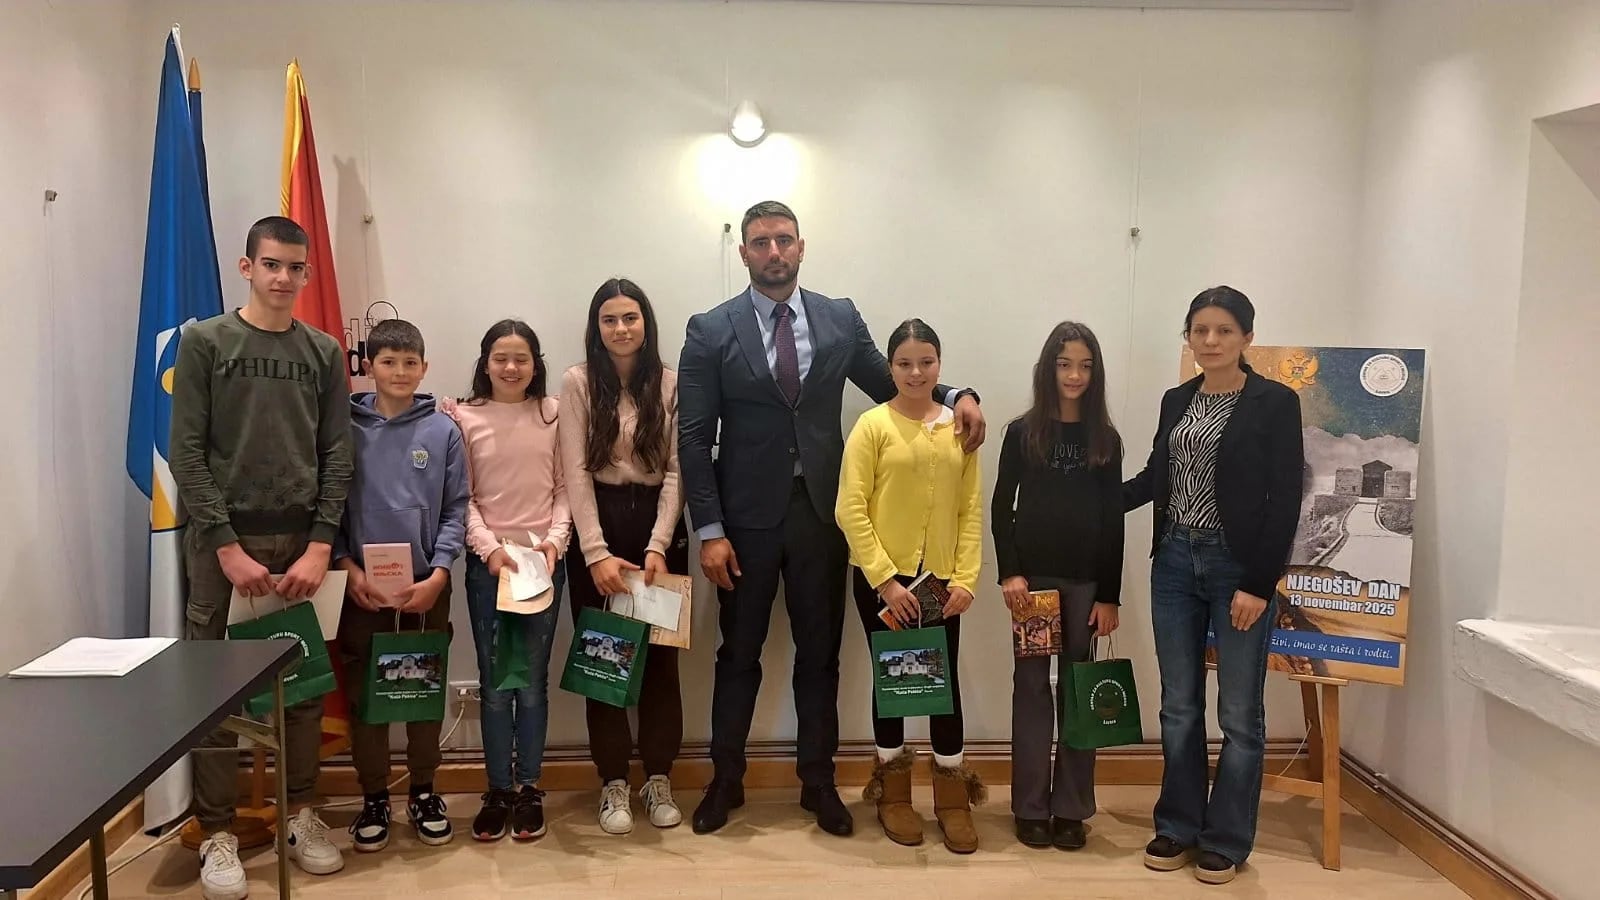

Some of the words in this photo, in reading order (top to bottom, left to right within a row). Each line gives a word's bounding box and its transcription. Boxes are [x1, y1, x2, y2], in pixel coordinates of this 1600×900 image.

[1054, 443, 1080, 460] LOVE
[1286, 574, 1362, 597] NJEGOŠEV
[1367, 581, 1401, 601] DAN
[1289, 593, 1302, 606] 13
[1304, 596, 1364, 614] novembar
[1364, 601, 1396, 616] 2025
[1293, 639, 1316, 650] imao
[1317, 643, 1328, 652] se
[1330, 643, 1355, 656] rašta
[1357, 646, 1362, 656] i
